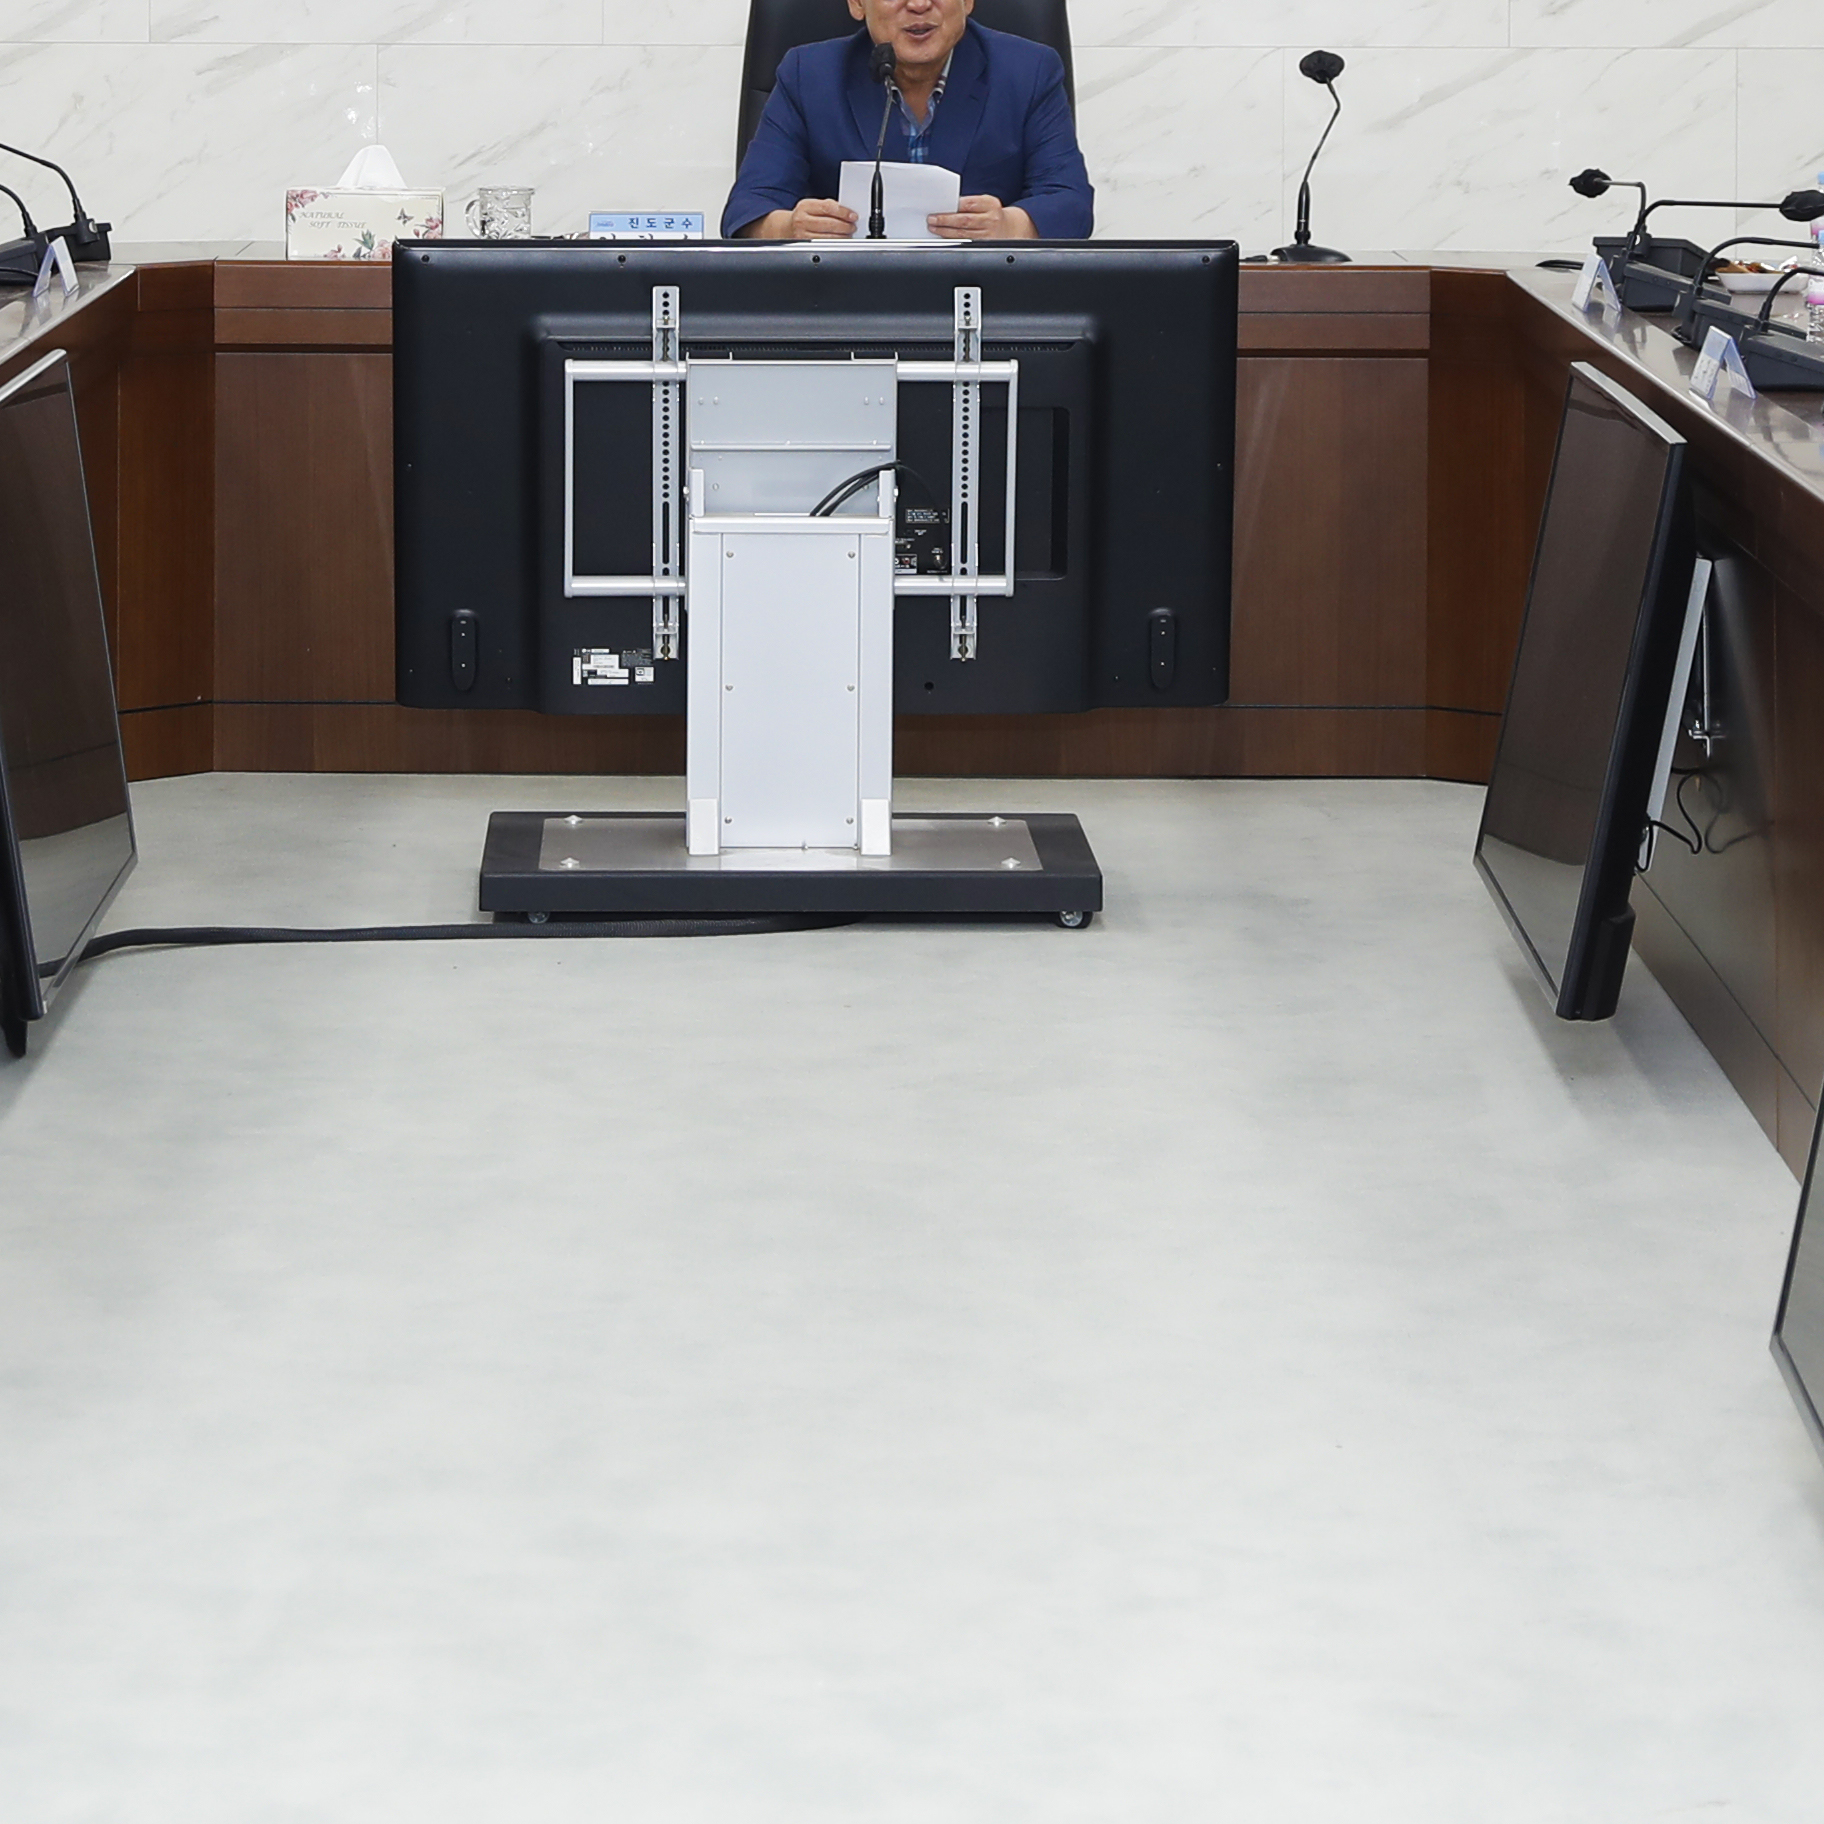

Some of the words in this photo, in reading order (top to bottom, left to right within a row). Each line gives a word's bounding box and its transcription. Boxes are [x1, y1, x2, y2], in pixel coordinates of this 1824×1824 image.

[299, 211, 345, 219] NATURAL
[308, 221, 331, 229] SOFT
[337, 221, 367, 229] TISSUE
